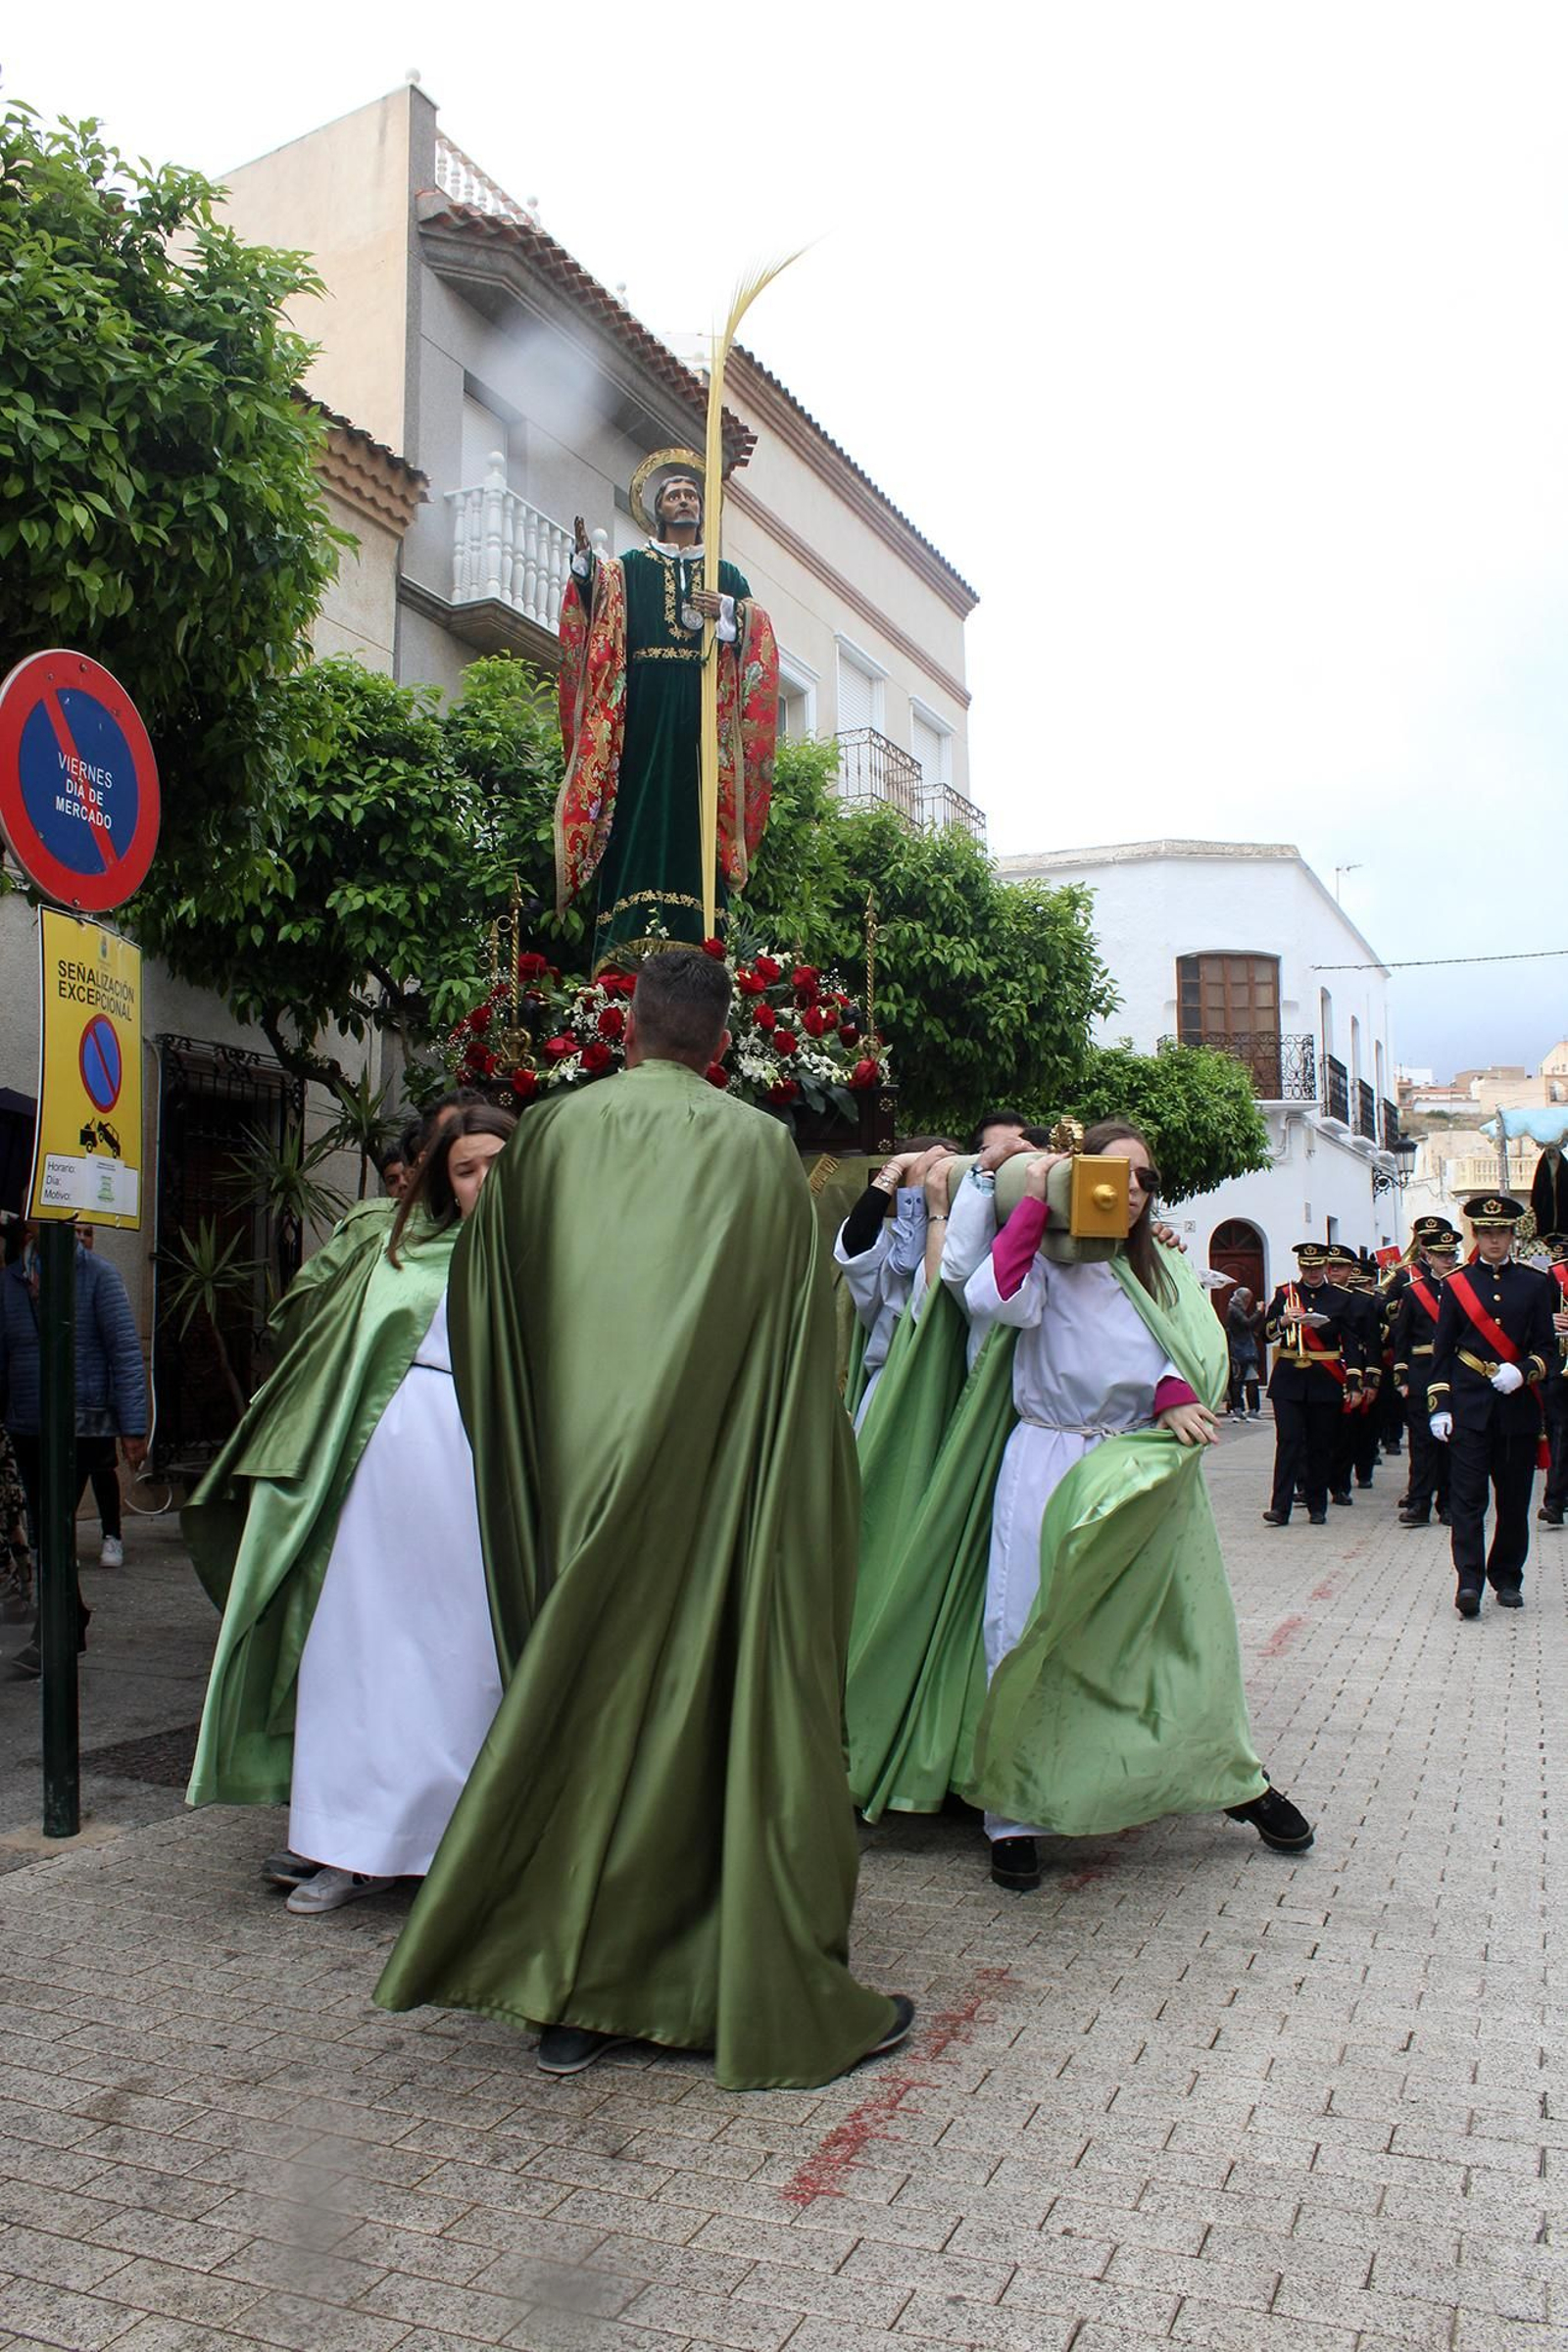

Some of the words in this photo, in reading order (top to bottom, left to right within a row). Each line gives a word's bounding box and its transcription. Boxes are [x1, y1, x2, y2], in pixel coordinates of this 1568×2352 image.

[58, 752, 113, 789] VIERNES
[56, 795, 112, 829] MERCADO
[88, 788, 104, 807] DE
[58, 959, 134, 1004] SEÑALIZACIÓN
[59, 980, 132, 1021] EXCEPCIONAL
